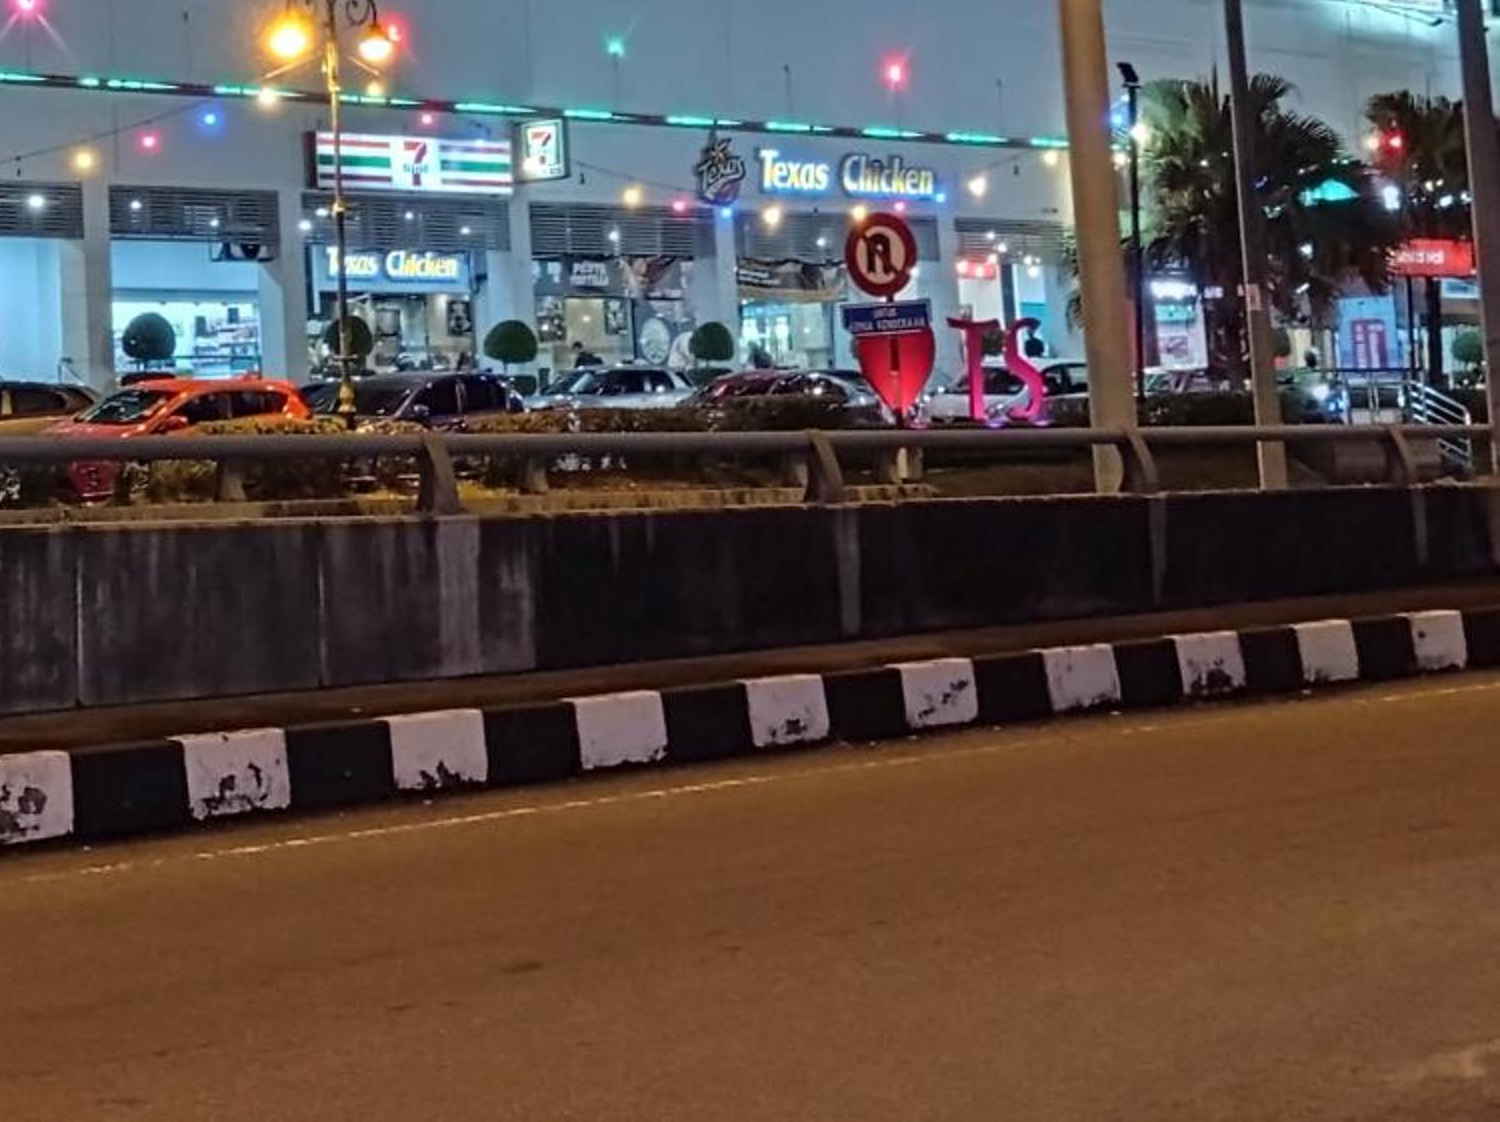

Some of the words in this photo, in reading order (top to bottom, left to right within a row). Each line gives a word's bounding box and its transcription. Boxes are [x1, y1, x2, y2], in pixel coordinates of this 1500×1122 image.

[758, 149, 830, 191] Texas
[841, 154, 935, 196] Chicken
[386, 249, 459, 278] Chicken
